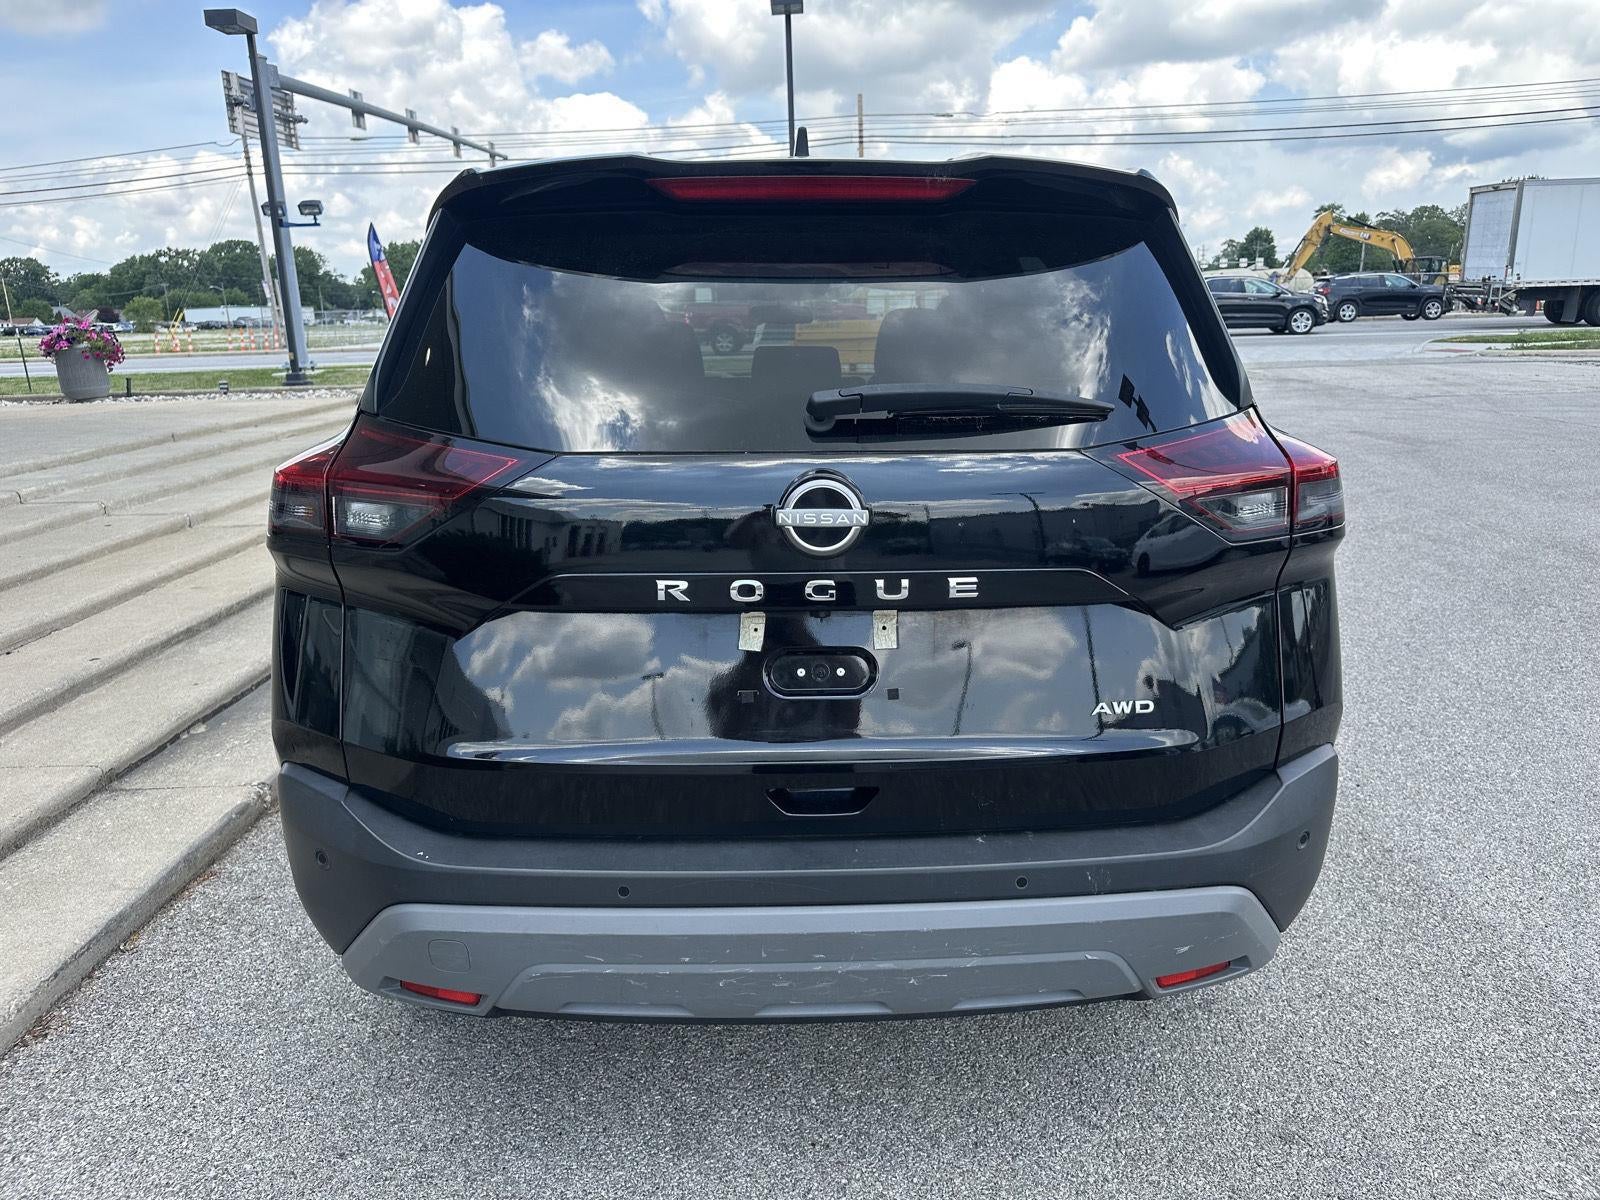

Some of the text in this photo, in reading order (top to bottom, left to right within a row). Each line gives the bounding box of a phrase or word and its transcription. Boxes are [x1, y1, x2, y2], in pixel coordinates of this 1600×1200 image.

[778, 513, 867, 524] NISSAN
[655, 576, 980, 603] ROGUE
[1091, 699, 1155, 716] AWD
